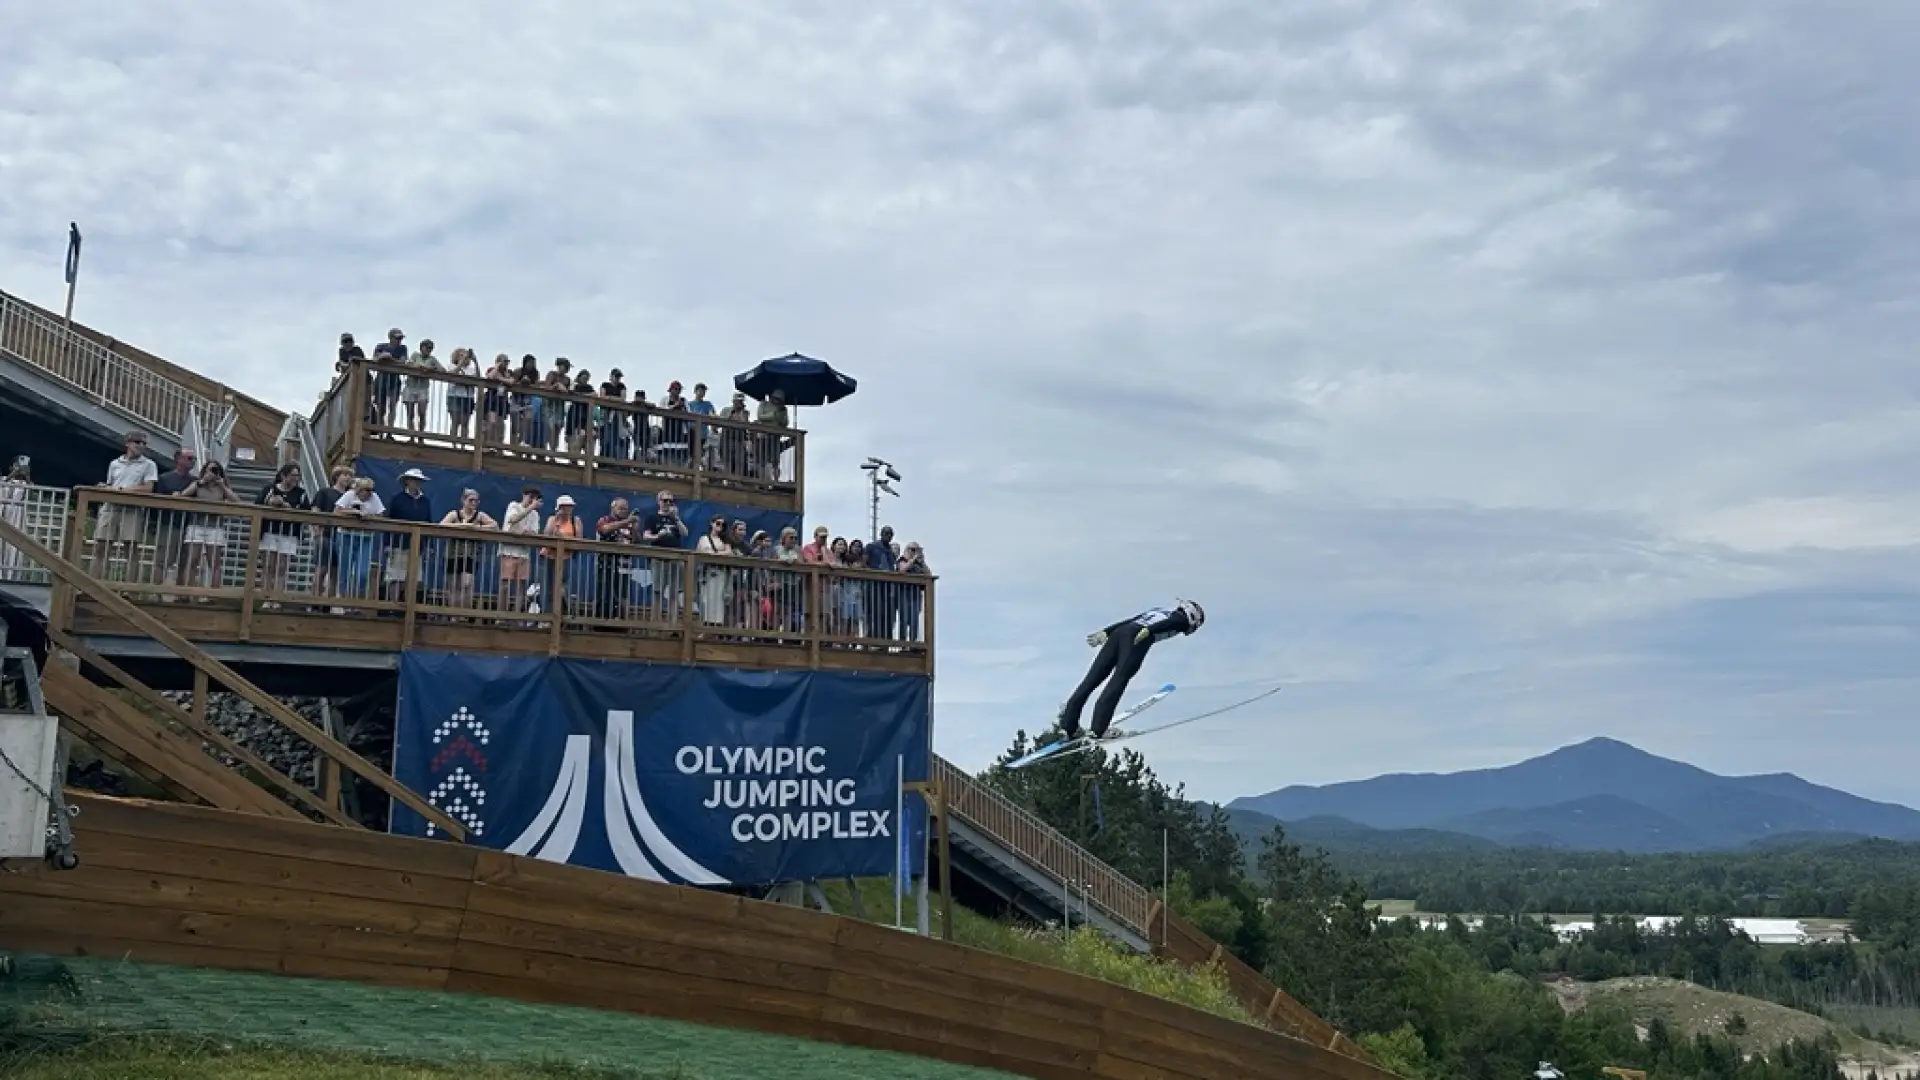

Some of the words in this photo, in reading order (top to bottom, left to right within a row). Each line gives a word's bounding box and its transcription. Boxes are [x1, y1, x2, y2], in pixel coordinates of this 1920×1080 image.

[675, 745, 826, 774] OLYMPIC
[703, 779, 856, 808] JUMPING
[731, 809, 890, 842] COMPLEX
